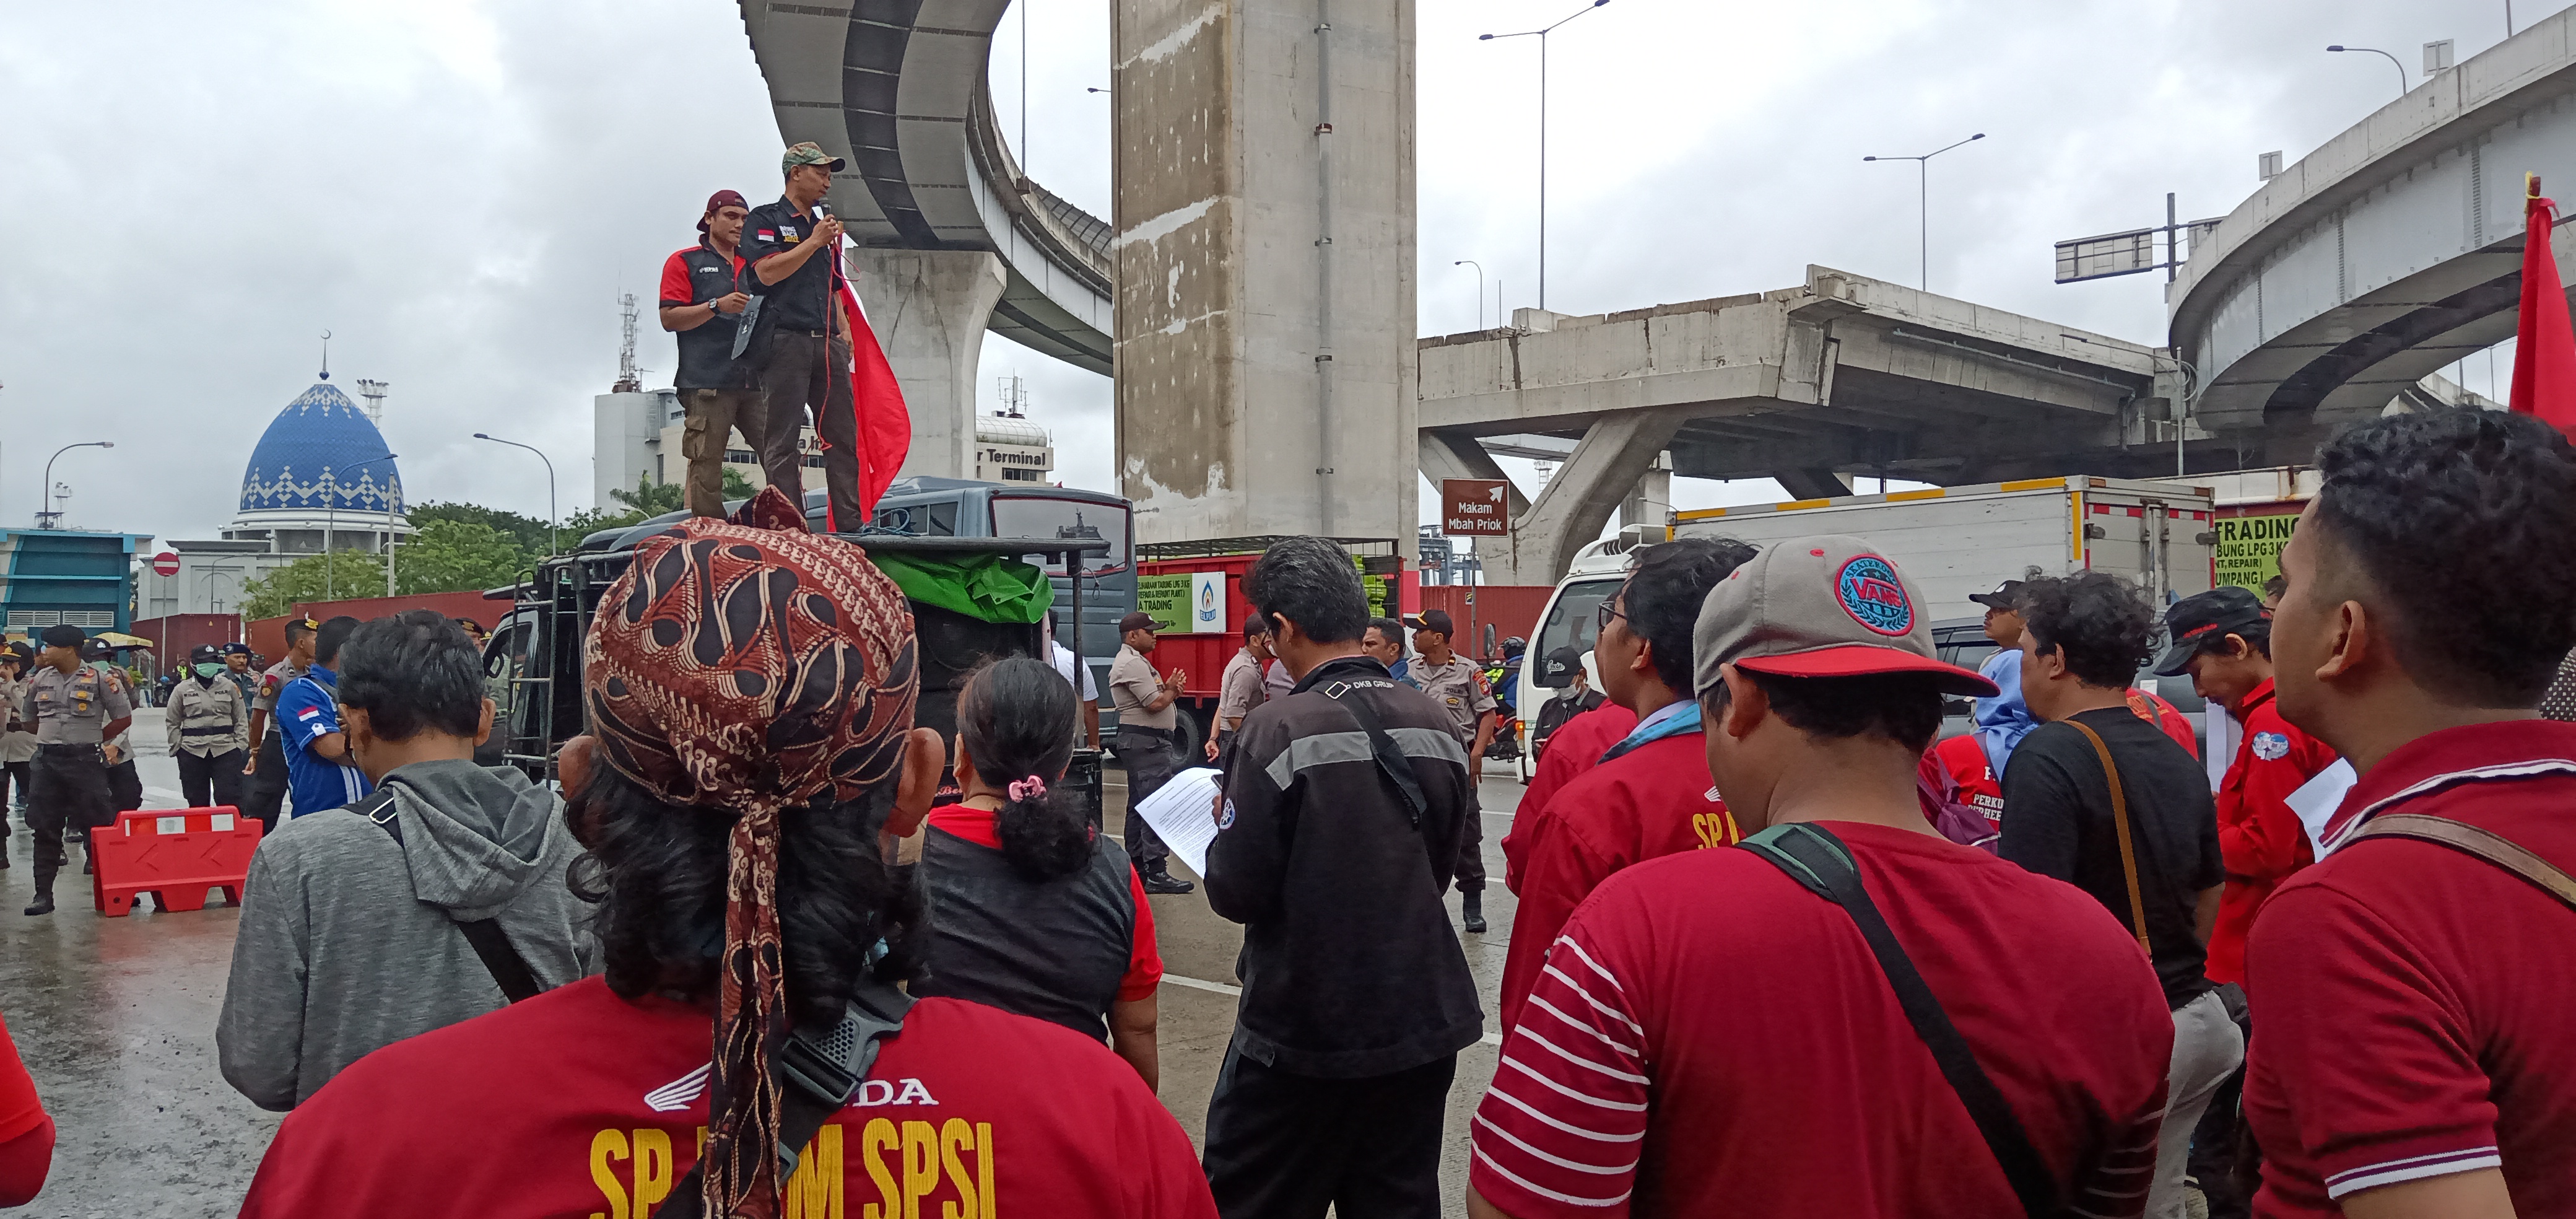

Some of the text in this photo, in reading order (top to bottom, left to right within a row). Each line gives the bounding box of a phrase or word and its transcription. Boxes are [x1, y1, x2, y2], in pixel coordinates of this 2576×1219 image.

[986, 448, 1045, 466] Terminal
[1458, 502, 1492, 513] Makam
[1449, 518, 1502, 530] Mbah Priok
[2248, 542, 2267, 556] LPG
[1850, 578, 1902, 608] VANS
[1144, 600, 1172, 611] TRADING
[1353, 681, 1372, 689] DKB
[590, 1128, 672, 1219] SP
[863, 1117, 996, 1219] SPSI
